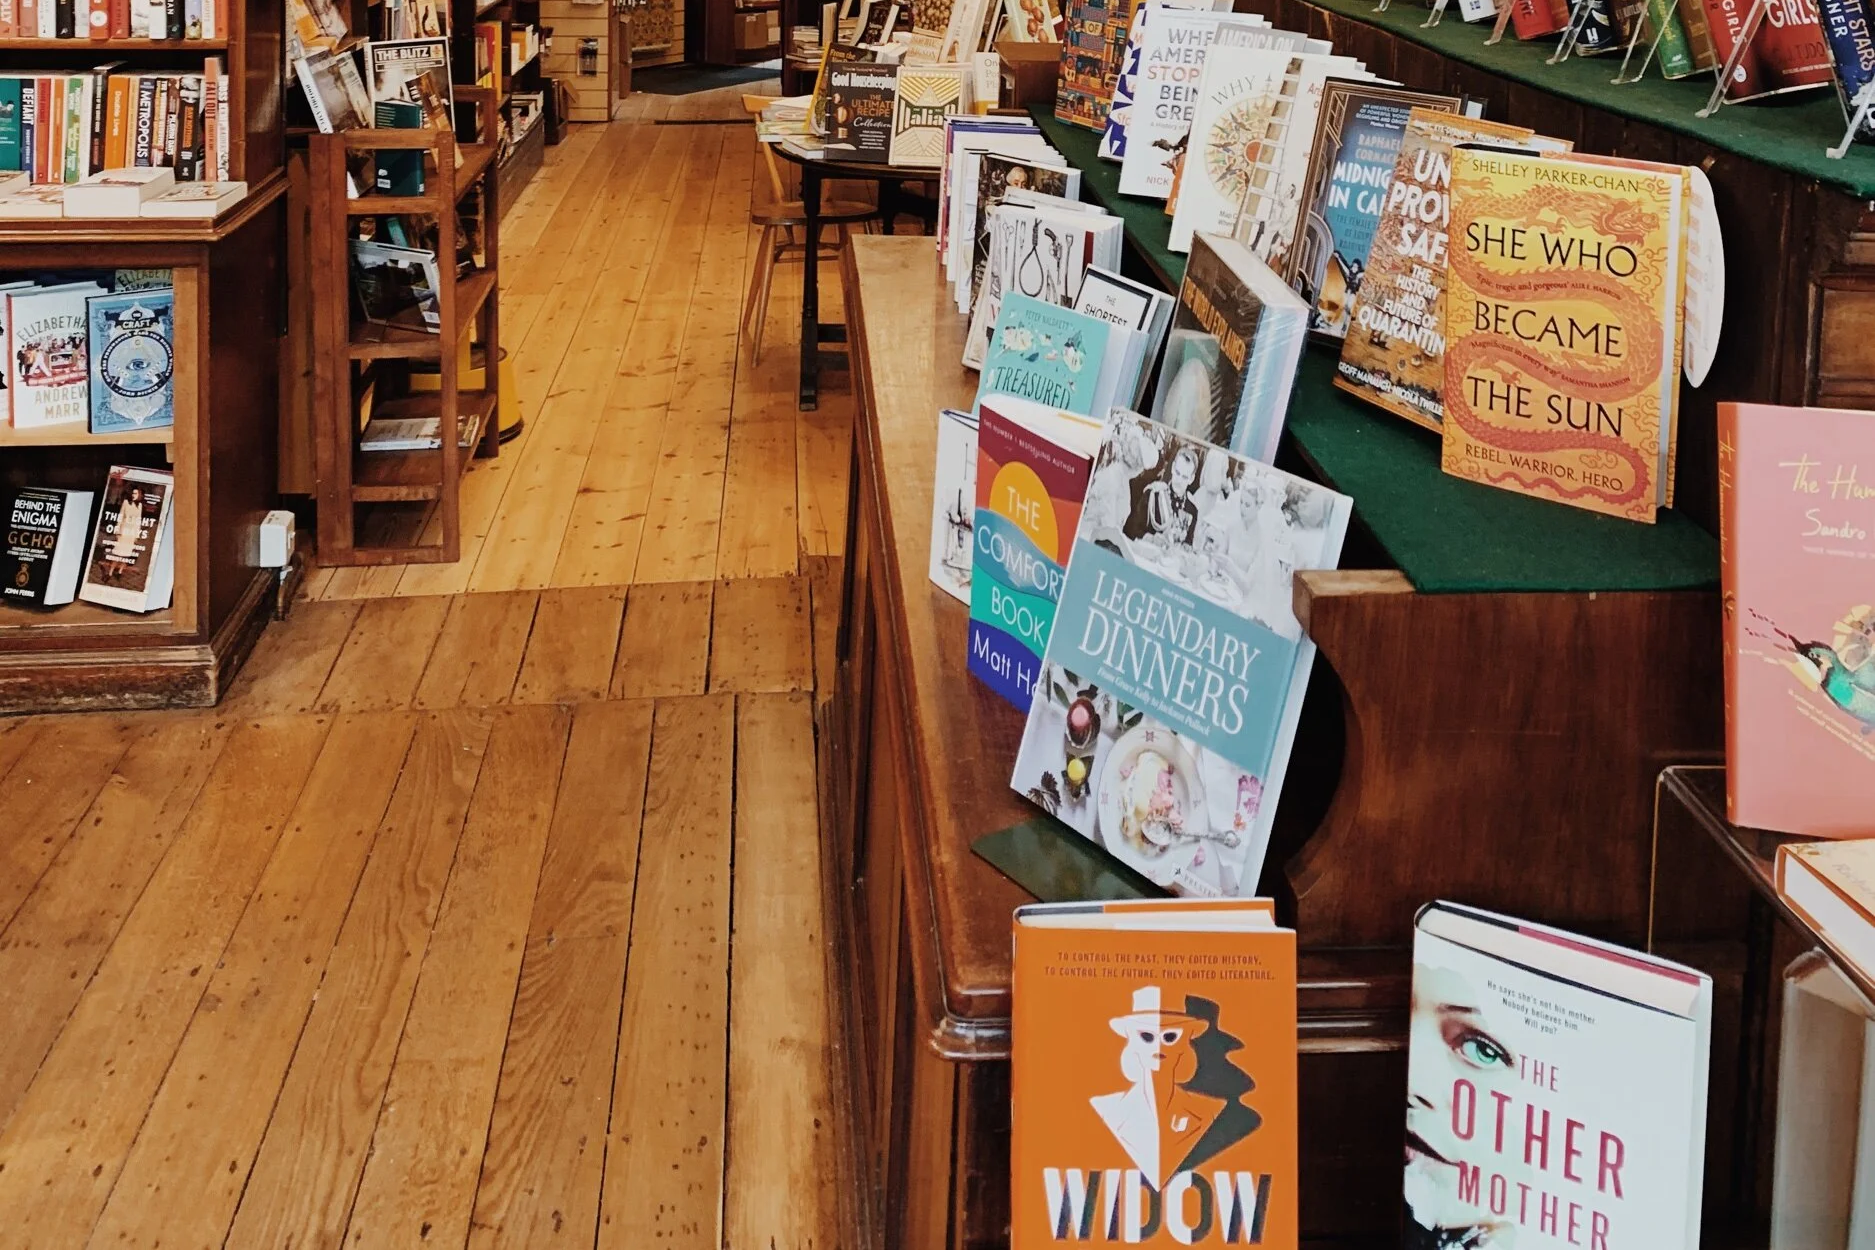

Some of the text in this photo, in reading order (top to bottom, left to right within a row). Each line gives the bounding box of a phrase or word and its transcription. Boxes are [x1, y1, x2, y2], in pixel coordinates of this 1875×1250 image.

[1088, 23, 1100, 34] OF
[1722, 0, 1747, 44] GIRLS
[376, 48, 429, 61] THE BLITZ
[1218, 28, 1295, 52] AMERICA ON
[1849, 18, 1875, 71] STARS
[22, 87, 34, 125] DEFIANT
[113, 90, 122, 117] Double
[205, 81, 216, 120] FALLOUT
[1211, 75, 1256, 106] WHY
[137, 90, 152, 158] METROPOLIS
[853, 117, 892, 128] Collection
[856, 108, 890, 117] RECIPE
[1145, 176, 1170, 186] NICK
[1473, 159, 1640, 193] SHELLEY PARKER-CHAN
[1328, 184, 1350, 209] IN
[1466, 222, 1638, 277] SHE WHO
[1396, 274, 1441, 300] HISTORY
[1411, 264, 1434, 283] THE
[1496, 281, 1532, 293] tragic and
[1083, 304, 1129, 327] SHORTEST
[1104, 294, 1117, 306] THE
[1383, 299, 1439, 330] FUTURE OF
[1401, 293, 1427, 310] AND
[123, 320, 150, 329] CRAFT
[1475, 300, 1623, 358] BECAME
[1338, 361, 1357, 379] GEOFF
[1523, 353, 1630, 388] every SAMANTHA SHANNON
[35, 387, 87, 404] ANDREW
[994, 366, 1072, 410] TREASURED
[45, 403, 81, 419] MARR
[1467, 375, 1624, 437] THE SUN
[1019, 440, 1075, 475] BESTSELLING AUTHOR
[1465, 443, 1624, 492] REBEL. WARRIOR. HERO.
[1778, 453, 1821, 493] The
[11, 510, 58, 527] ENIGMA
[14, 499, 61, 513] BEHIND THE
[1007, 485, 1041, 532] THE
[1801, 508, 1866, 540] Sandro
[8, 531, 54, 549] GCHQ
[4, 587, 19, 596] JOHN
[991, 586, 1046, 648] BOOK
[1092, 570, 1261, 682] LEGENDARY
[973, 630, 1011, 680] Matt
[1078, 606, 1249, 735] DINNERS
[1098, 667, 1210, 736] From Grace Kelly Jackson Pollock
[1045, 967, 1056, 977] TO
[1059, 968, 1097, 977] CONTROL
[1102, 969, 1117, 978] THE
[1162, 970, 1183, 980] THEY
[1187, 970, 1216, 980] EDITED
[1058, 952, 1069, 961] TO
[1072, 953, 1110, 962] CONTROL
[1115, 954, 1131, 963] THE
[1164, 955, 1185, 964] THEY
[1189, 956, 1218, 965] EDITED
[1487, 980, 1566, 1014] He says she's not his
[1502, 997, 1562, 1025] Nobody believes
[1524, 1016, 1558, 1036] Will you?
[1519, 1054, 1560, 1093] THE
[1451, 1078, 1626, 1201] OTHER
[1043, 1167, 1272, 1245] WIDOW
[1458, 1161, 1612, 1250] MOTHER
